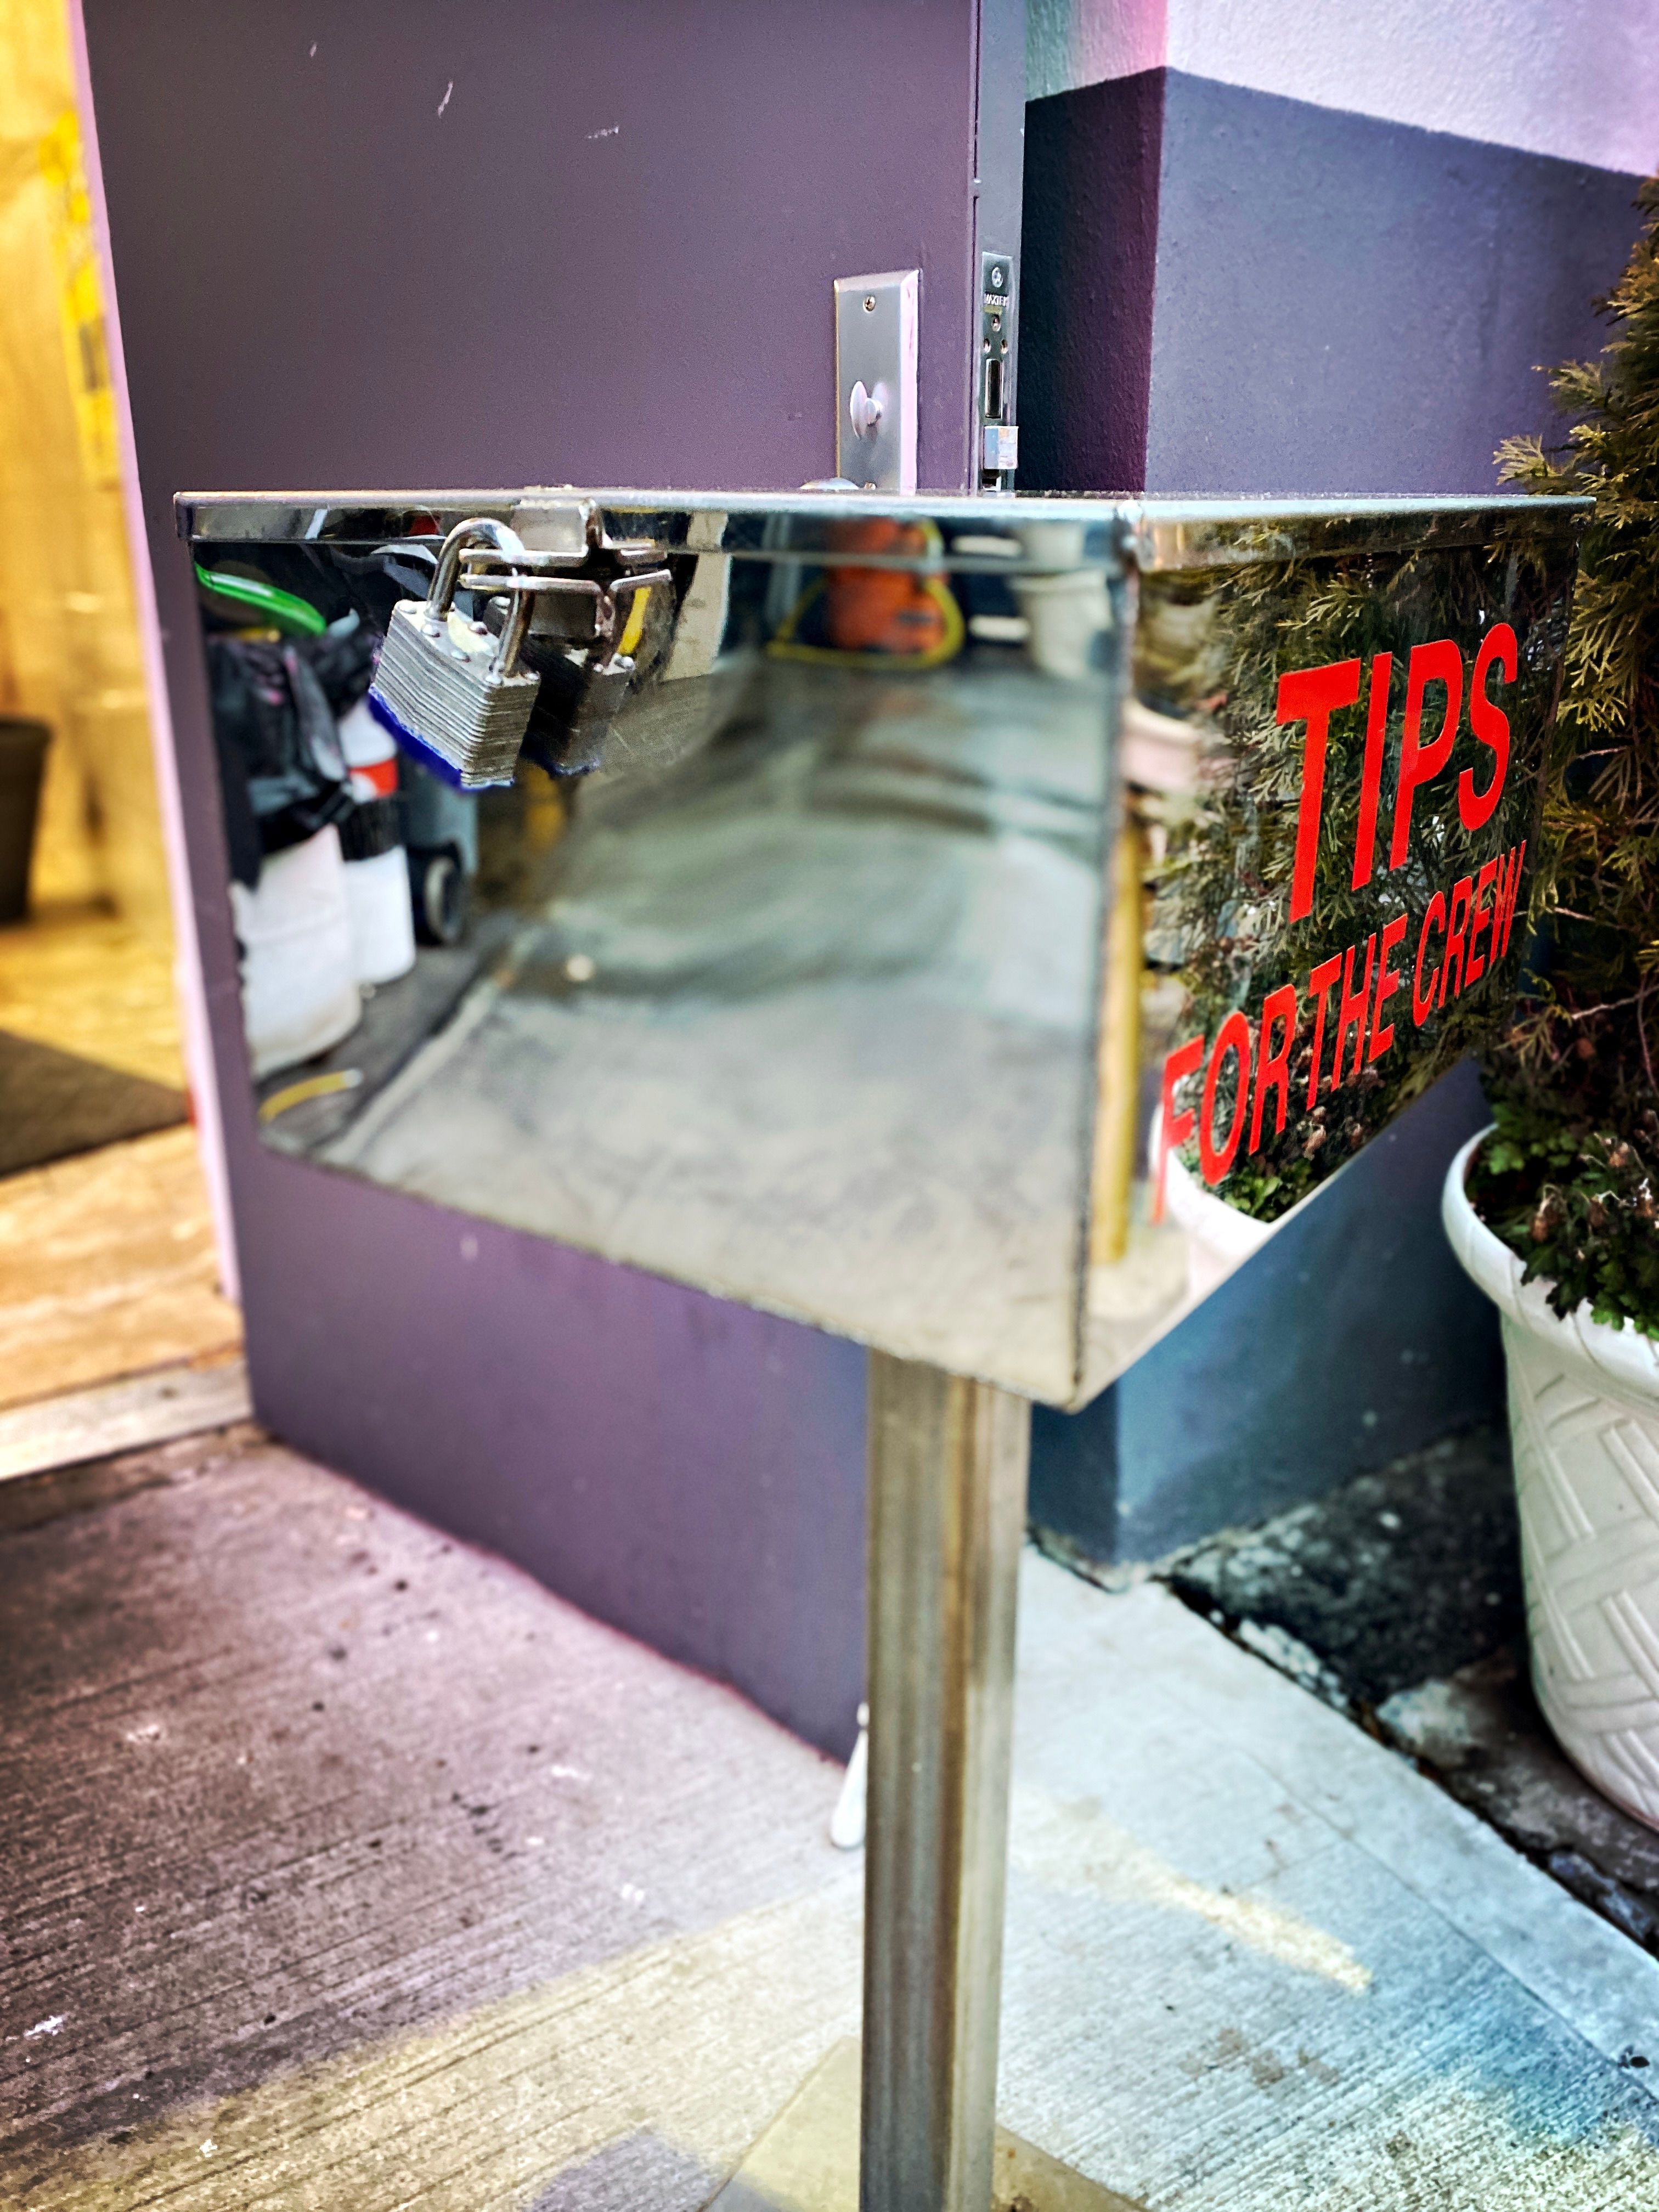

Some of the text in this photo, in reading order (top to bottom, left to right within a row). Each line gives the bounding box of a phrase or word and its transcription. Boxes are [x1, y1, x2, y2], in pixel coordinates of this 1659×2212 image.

[1276, 623, 1518, 923] TIPS
[1150, 842, 1526, 1228] FOR THE CREW
